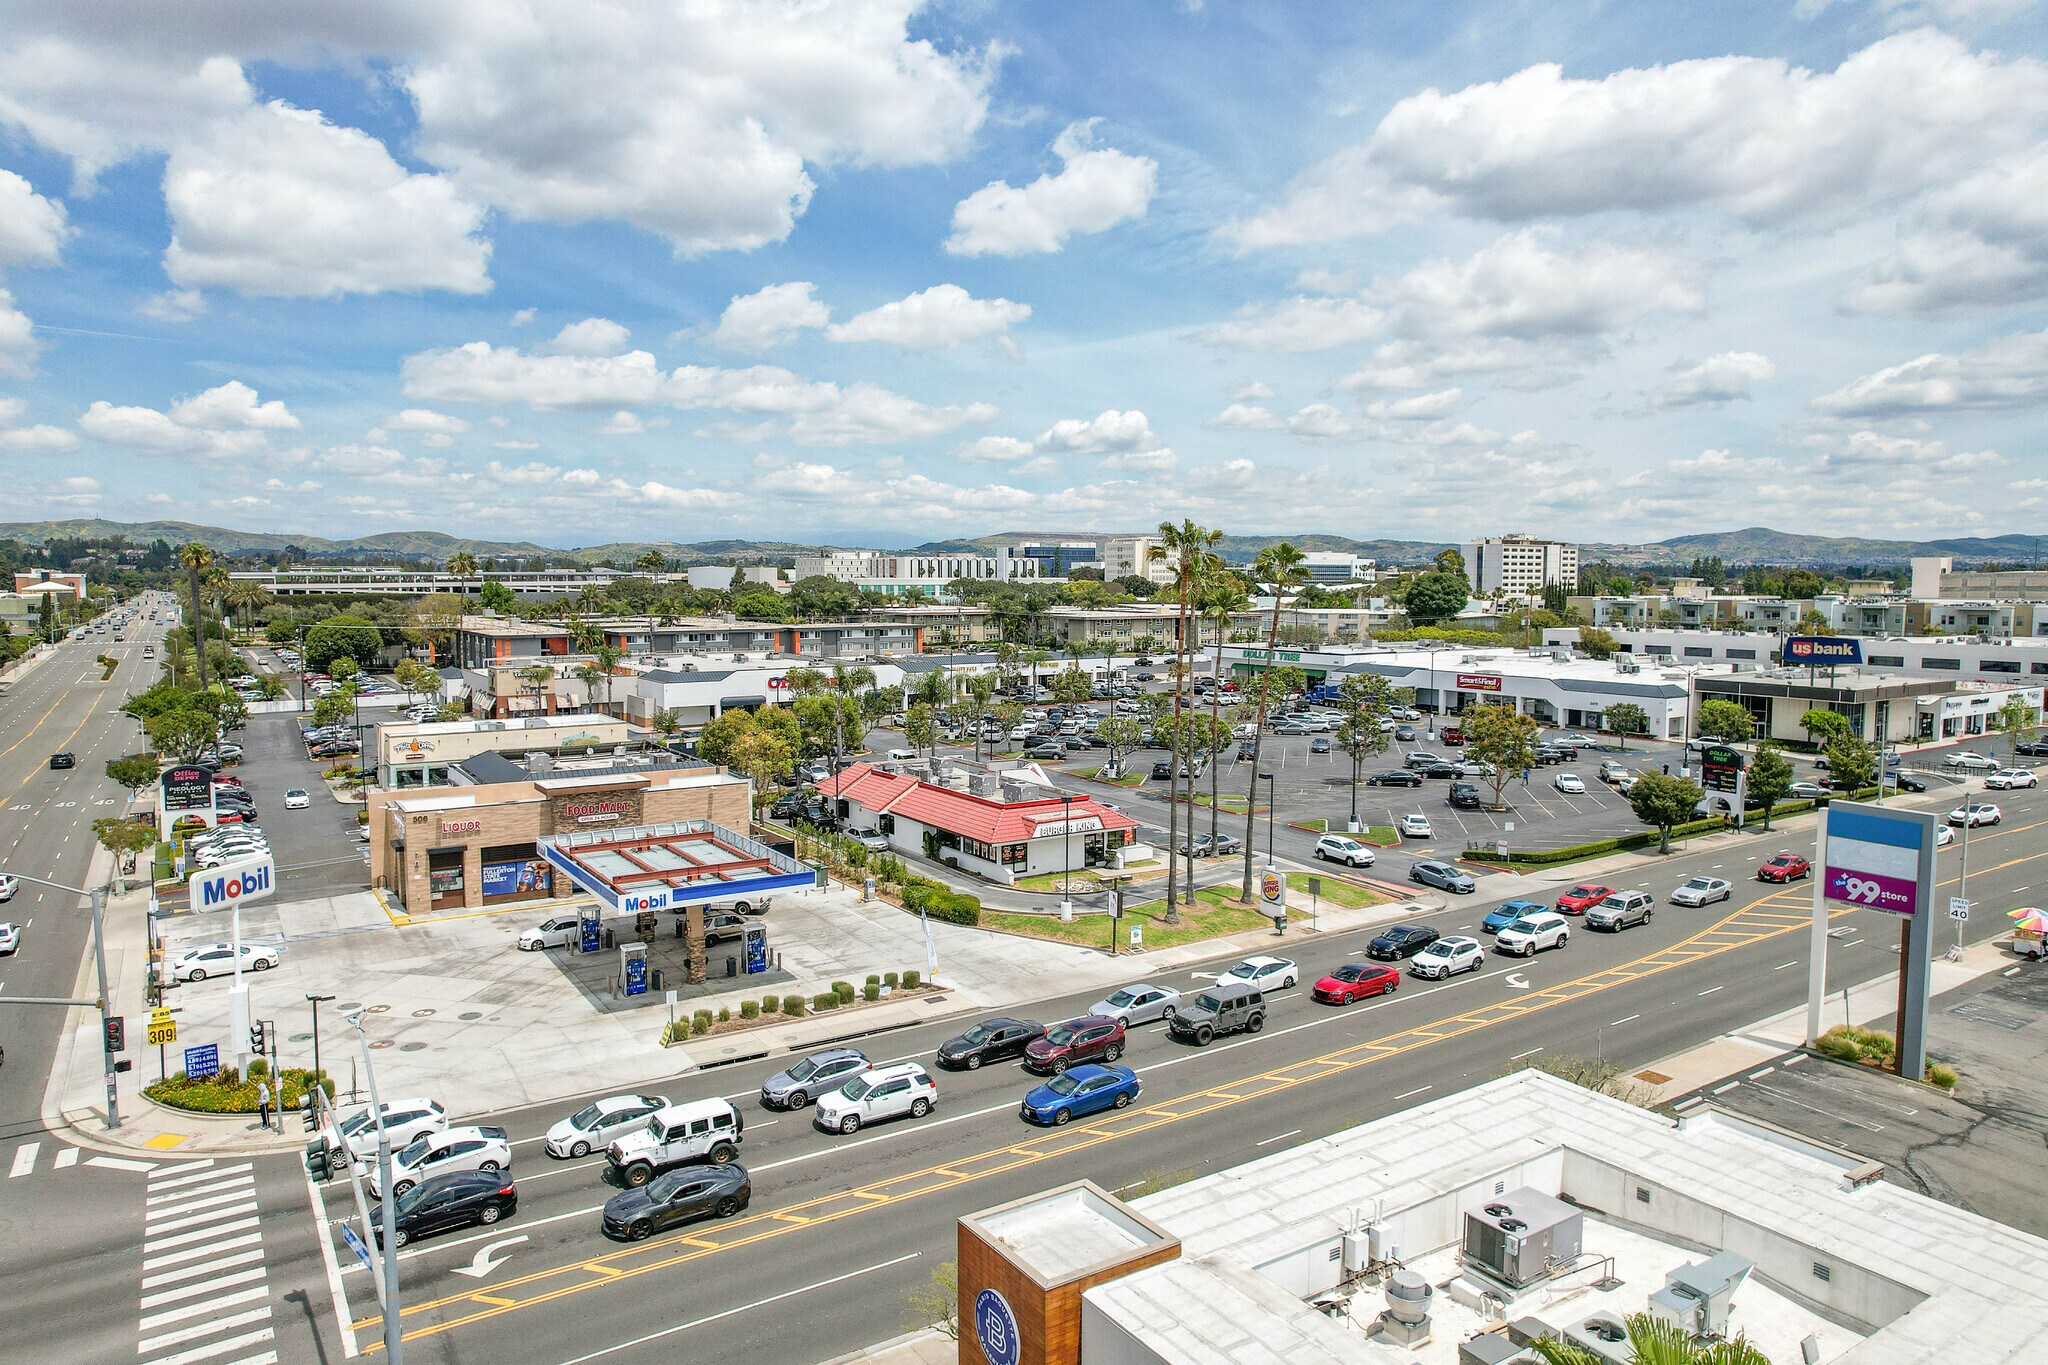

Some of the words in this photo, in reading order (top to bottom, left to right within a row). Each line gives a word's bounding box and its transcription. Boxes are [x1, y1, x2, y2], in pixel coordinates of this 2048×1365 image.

[1793, 644, 1811, 654] us
[1814, 642, 1853, 655] bank
[1279, 652, 1300, 661] TREE
[568, 805, 594, 816] FOOD
[599, 801, 629, 812] MART
[413, 814, 428, 823] 506
[442, 821, 480, 832] LIQUOR
[1076, 821, 1096, 831] KING
[203, 866, 269, 906] Mobil
[1846, 878, 1880, 904] 99
[1881, 891, 1908, 902] store
[626, 894, 666, 911] Mobil
[1950, 910, 1967, 918] 40
[150, 1028, 173, 1044] 309
[978, 1293, 989, 1310] PARIS
[990, 1294, 1014, 1338] BAGUETTE
